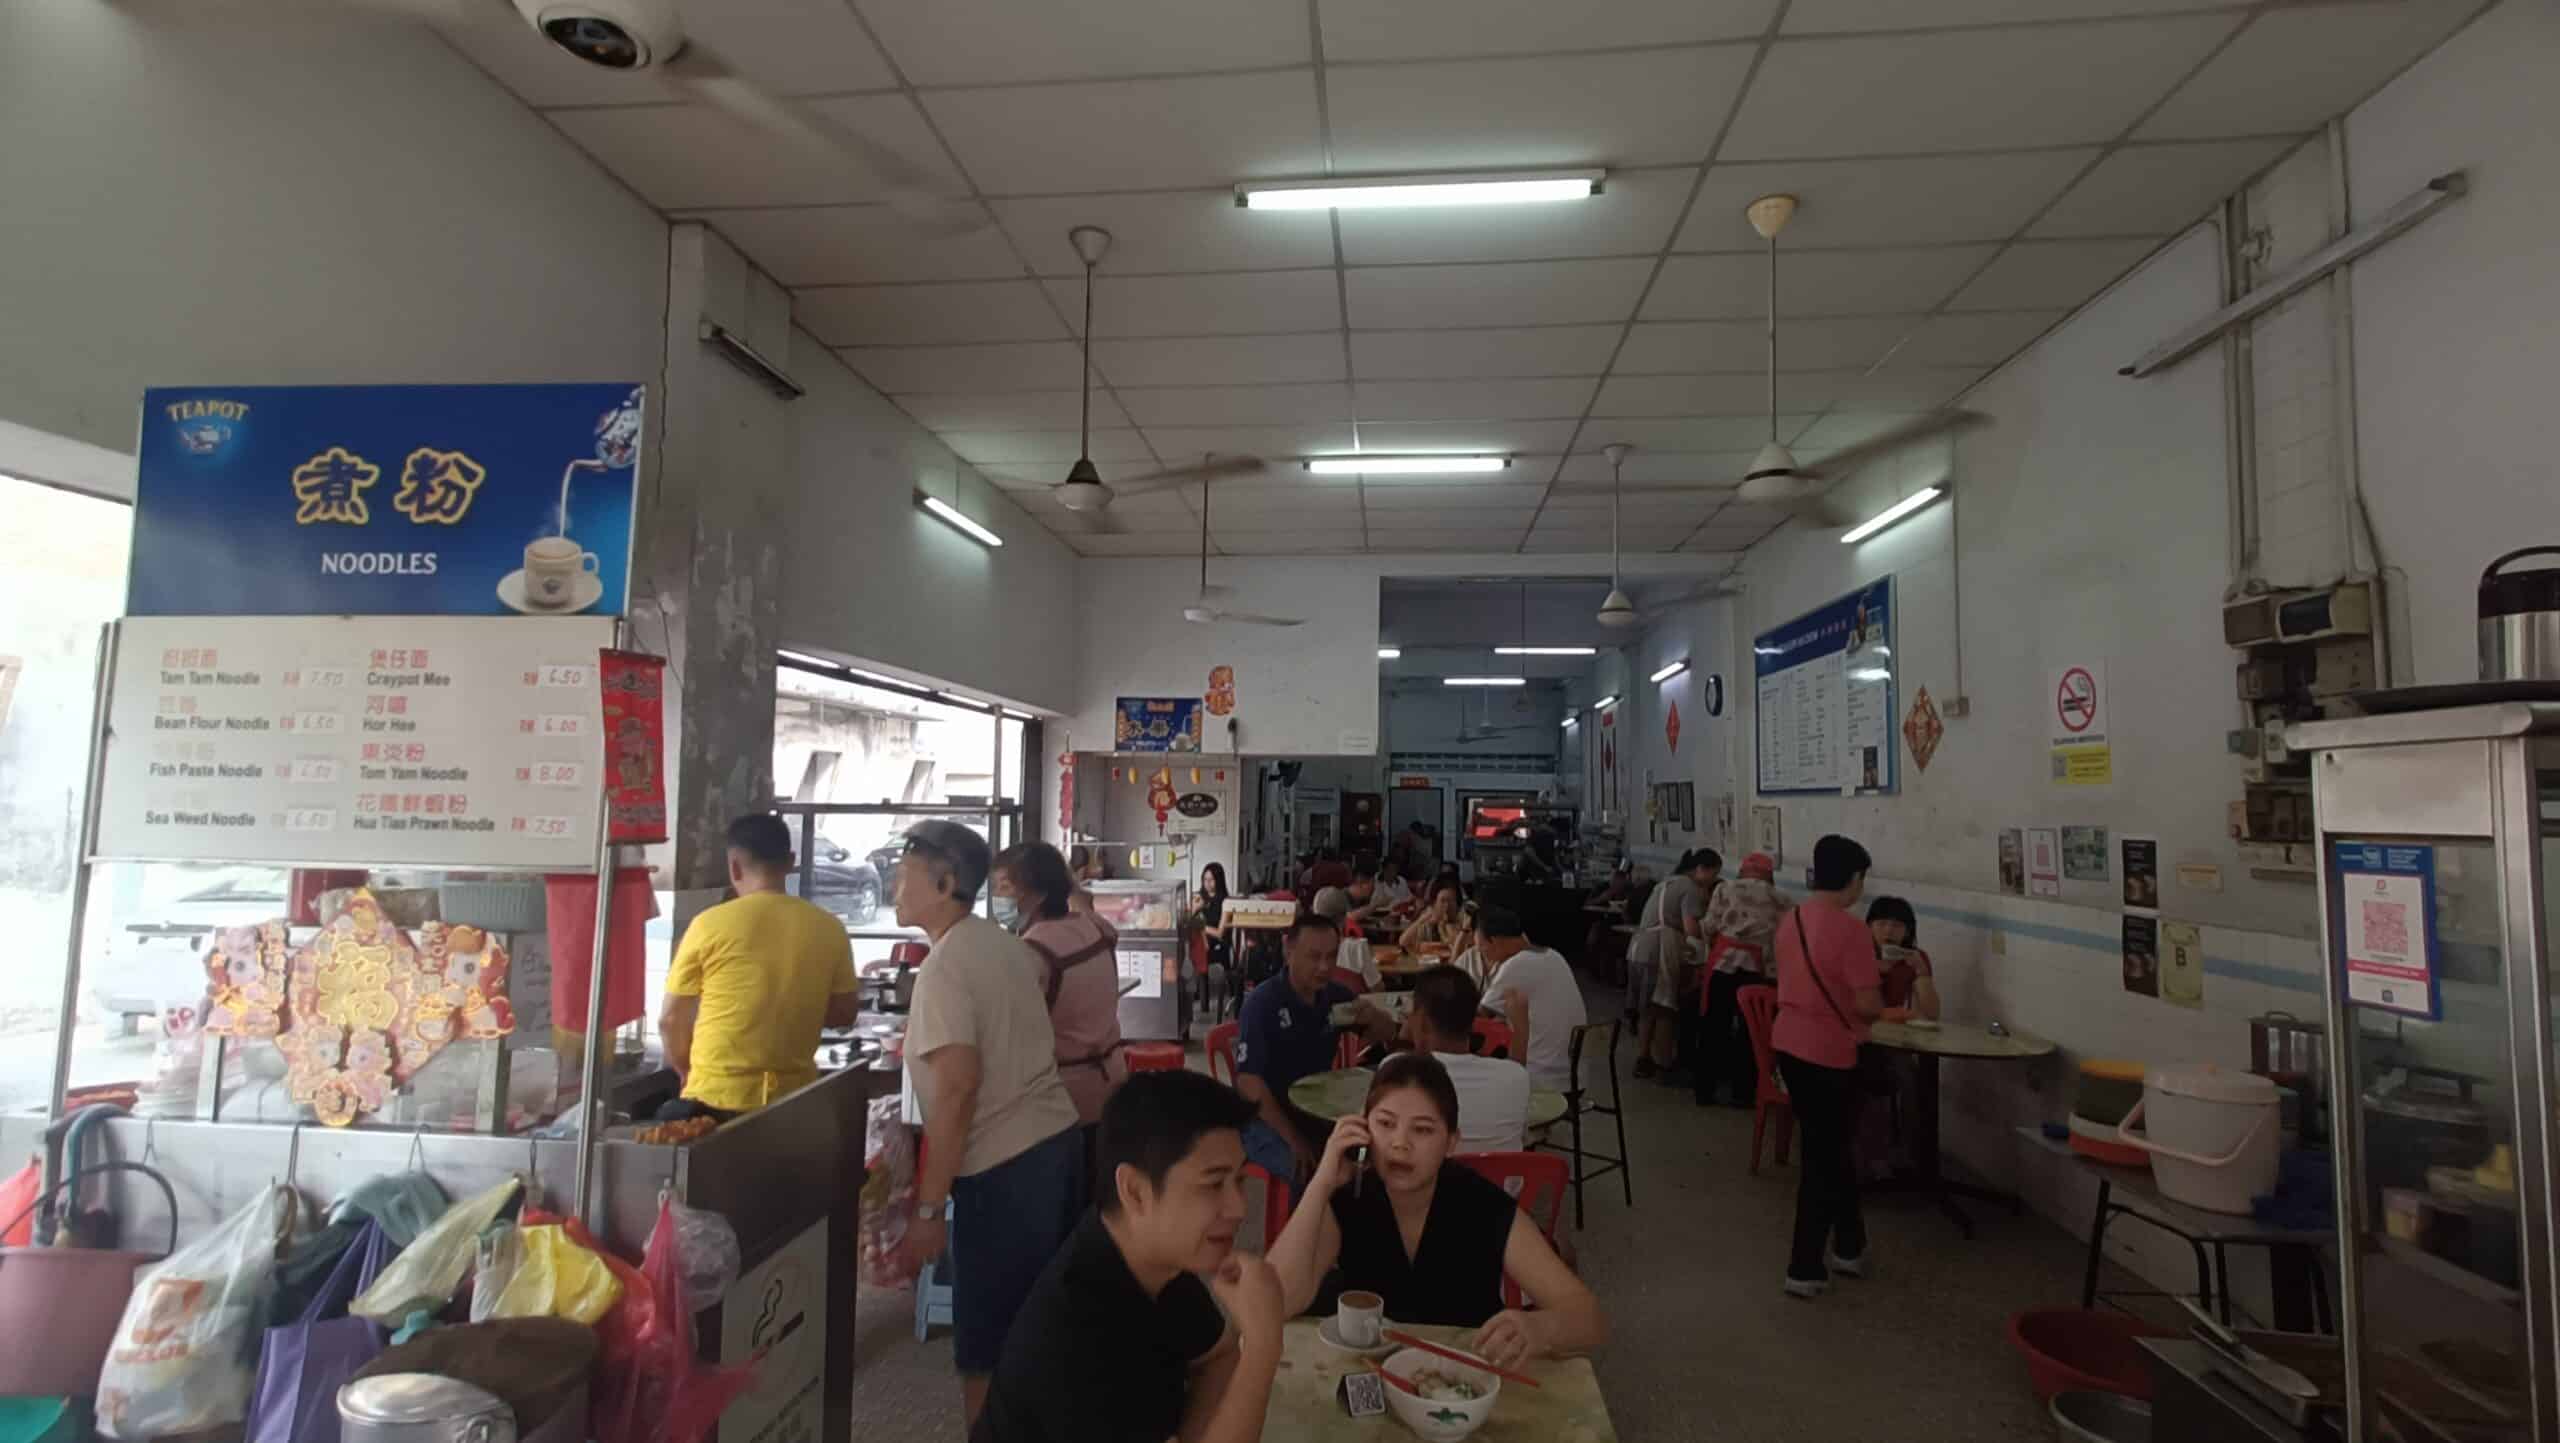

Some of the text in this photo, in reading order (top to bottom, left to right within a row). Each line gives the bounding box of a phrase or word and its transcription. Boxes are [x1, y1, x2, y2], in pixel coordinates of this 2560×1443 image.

[167, 400, 250, 423] TEAPOT
[292, 446, 485, 525] 煮粉
[321, 552, 437, 576] NOODLES
[161, 671, 184, 685] Tam
[190, 671, 214, 685] Tam
[217, 671, 261, 686] Noodle
[424, 673, 450, 686] Mee
[155, 716, 186, 729] Bean
[190, 716, 221, 729] Flour
[226, 716, 270, 730] Noodle
[362, 719, 386, 732] Hor
[150, 763, 176, 777] Fish
[180, 763, 214, 777] Paste
[218, 764, 263, 778] Noodle
[359, 766, 386, 779] Tom
[391, 767, 417, 780] Yam
[421, 767, 468, 781] Noodle
[145, 811, 169, 826] Sea
[174, 812, 208, 826] Weed
[211, 812, 255, 827] Noodle
[409, 818, 449, 832] Prawn
[452, 819, 495, 832] Noodle
[2175, 946, 2187, 967] B
[1278, 1007, 1293, 1028] 3
